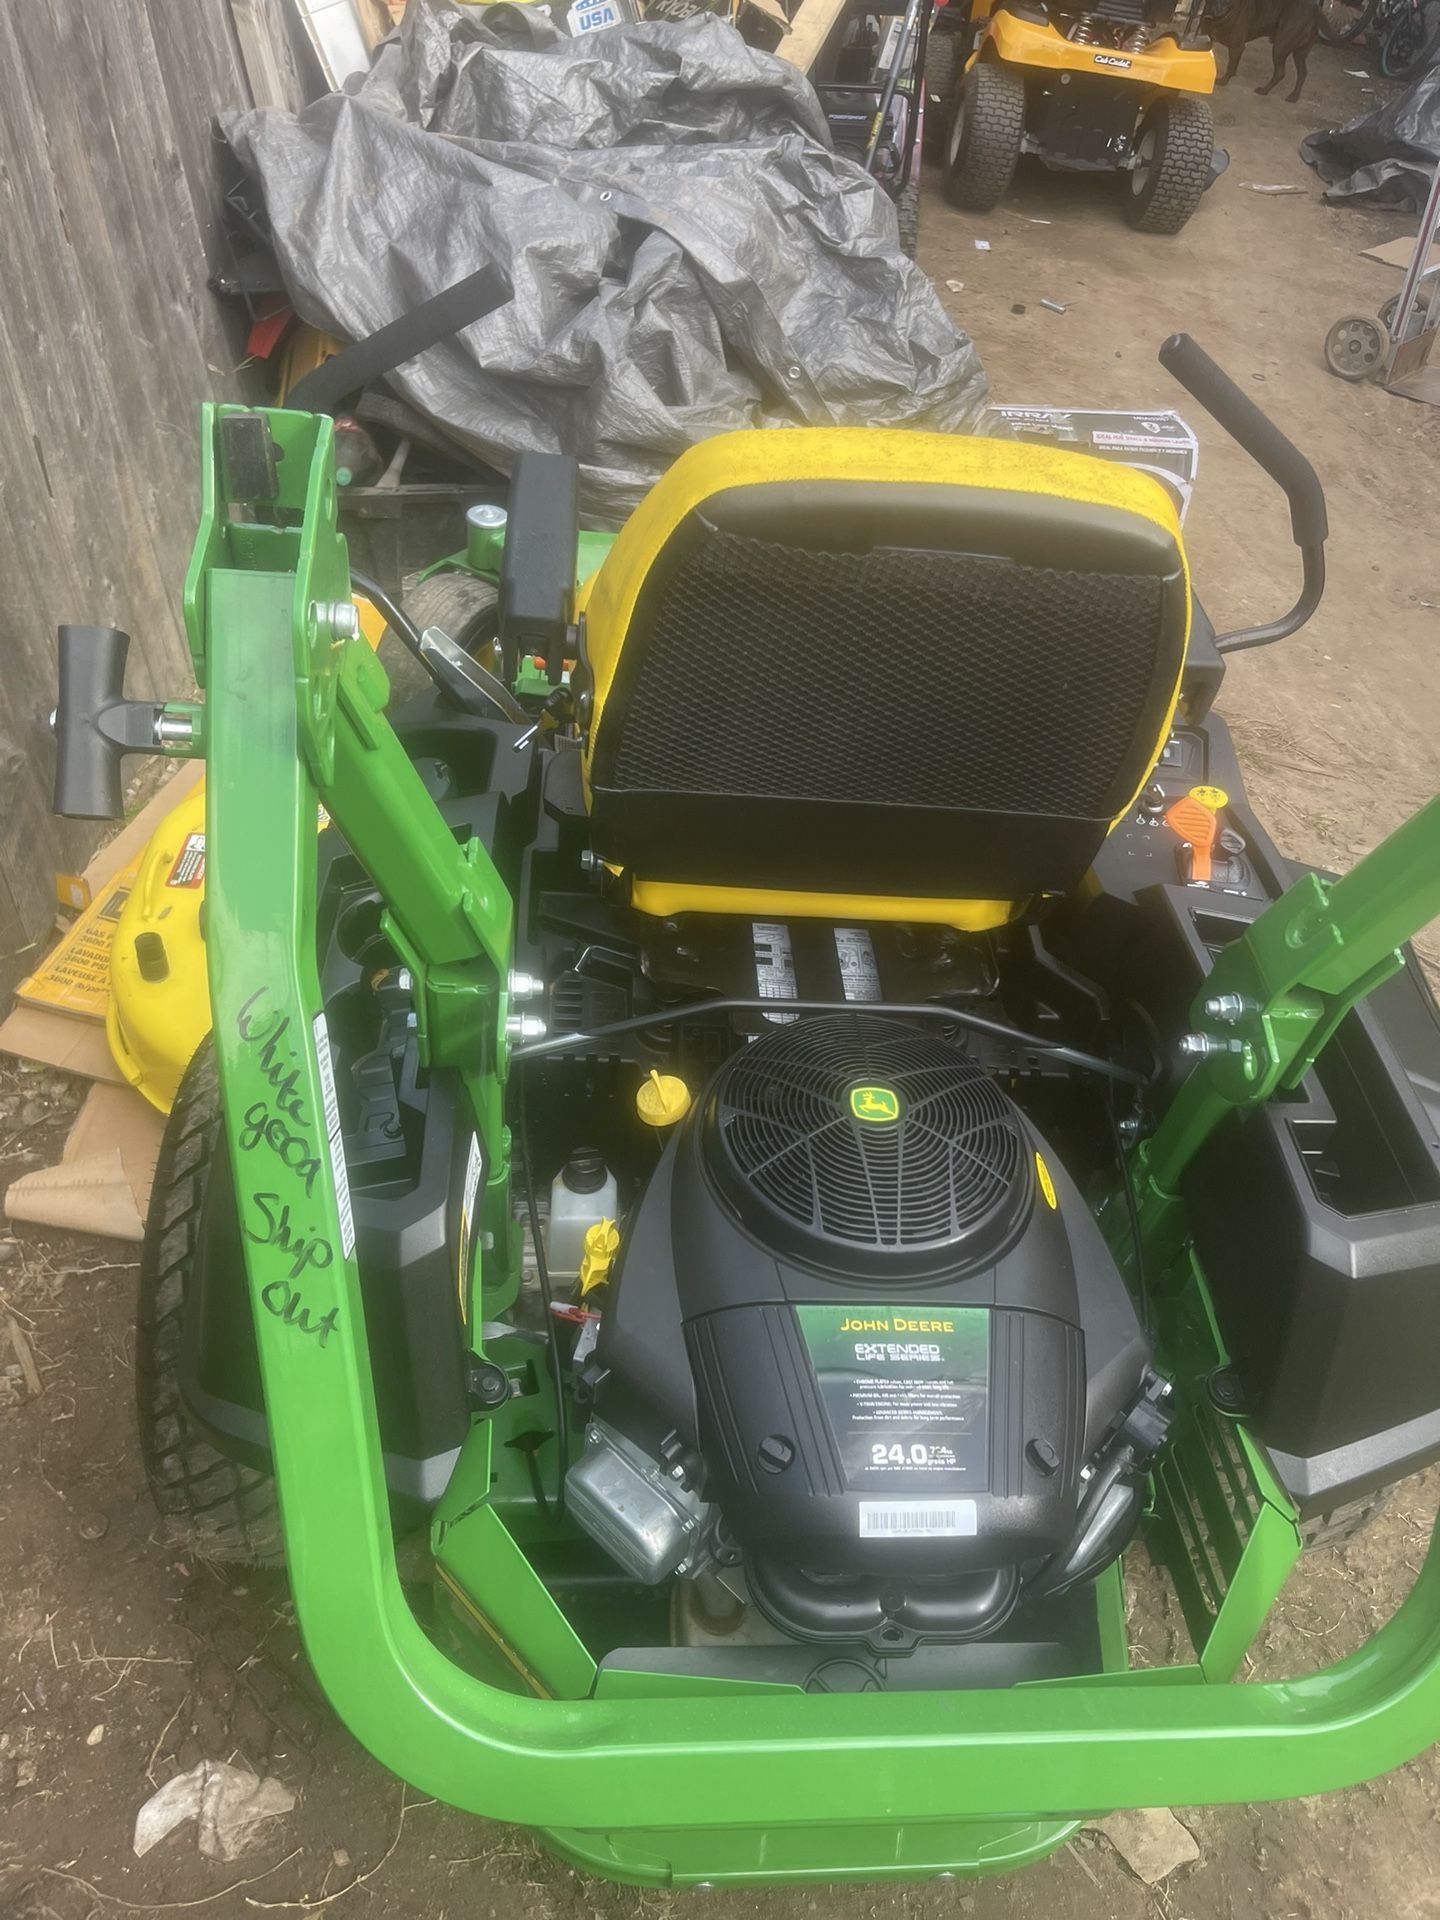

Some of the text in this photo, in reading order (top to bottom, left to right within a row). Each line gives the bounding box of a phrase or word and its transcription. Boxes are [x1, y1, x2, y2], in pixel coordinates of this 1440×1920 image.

[580, 7, 614, 30] USA
[1095, 55, 1131, 68] Cub Cadet
[243, 1193, 333, 1279] Ship
[840, 1318, 954, 1332] JOHN DEERE
[854, 1343, 940, 1354] EXTENDED
[856, 1353, 885, 1361] LIFE
[871, 1443, 927, 1464] 24.0
